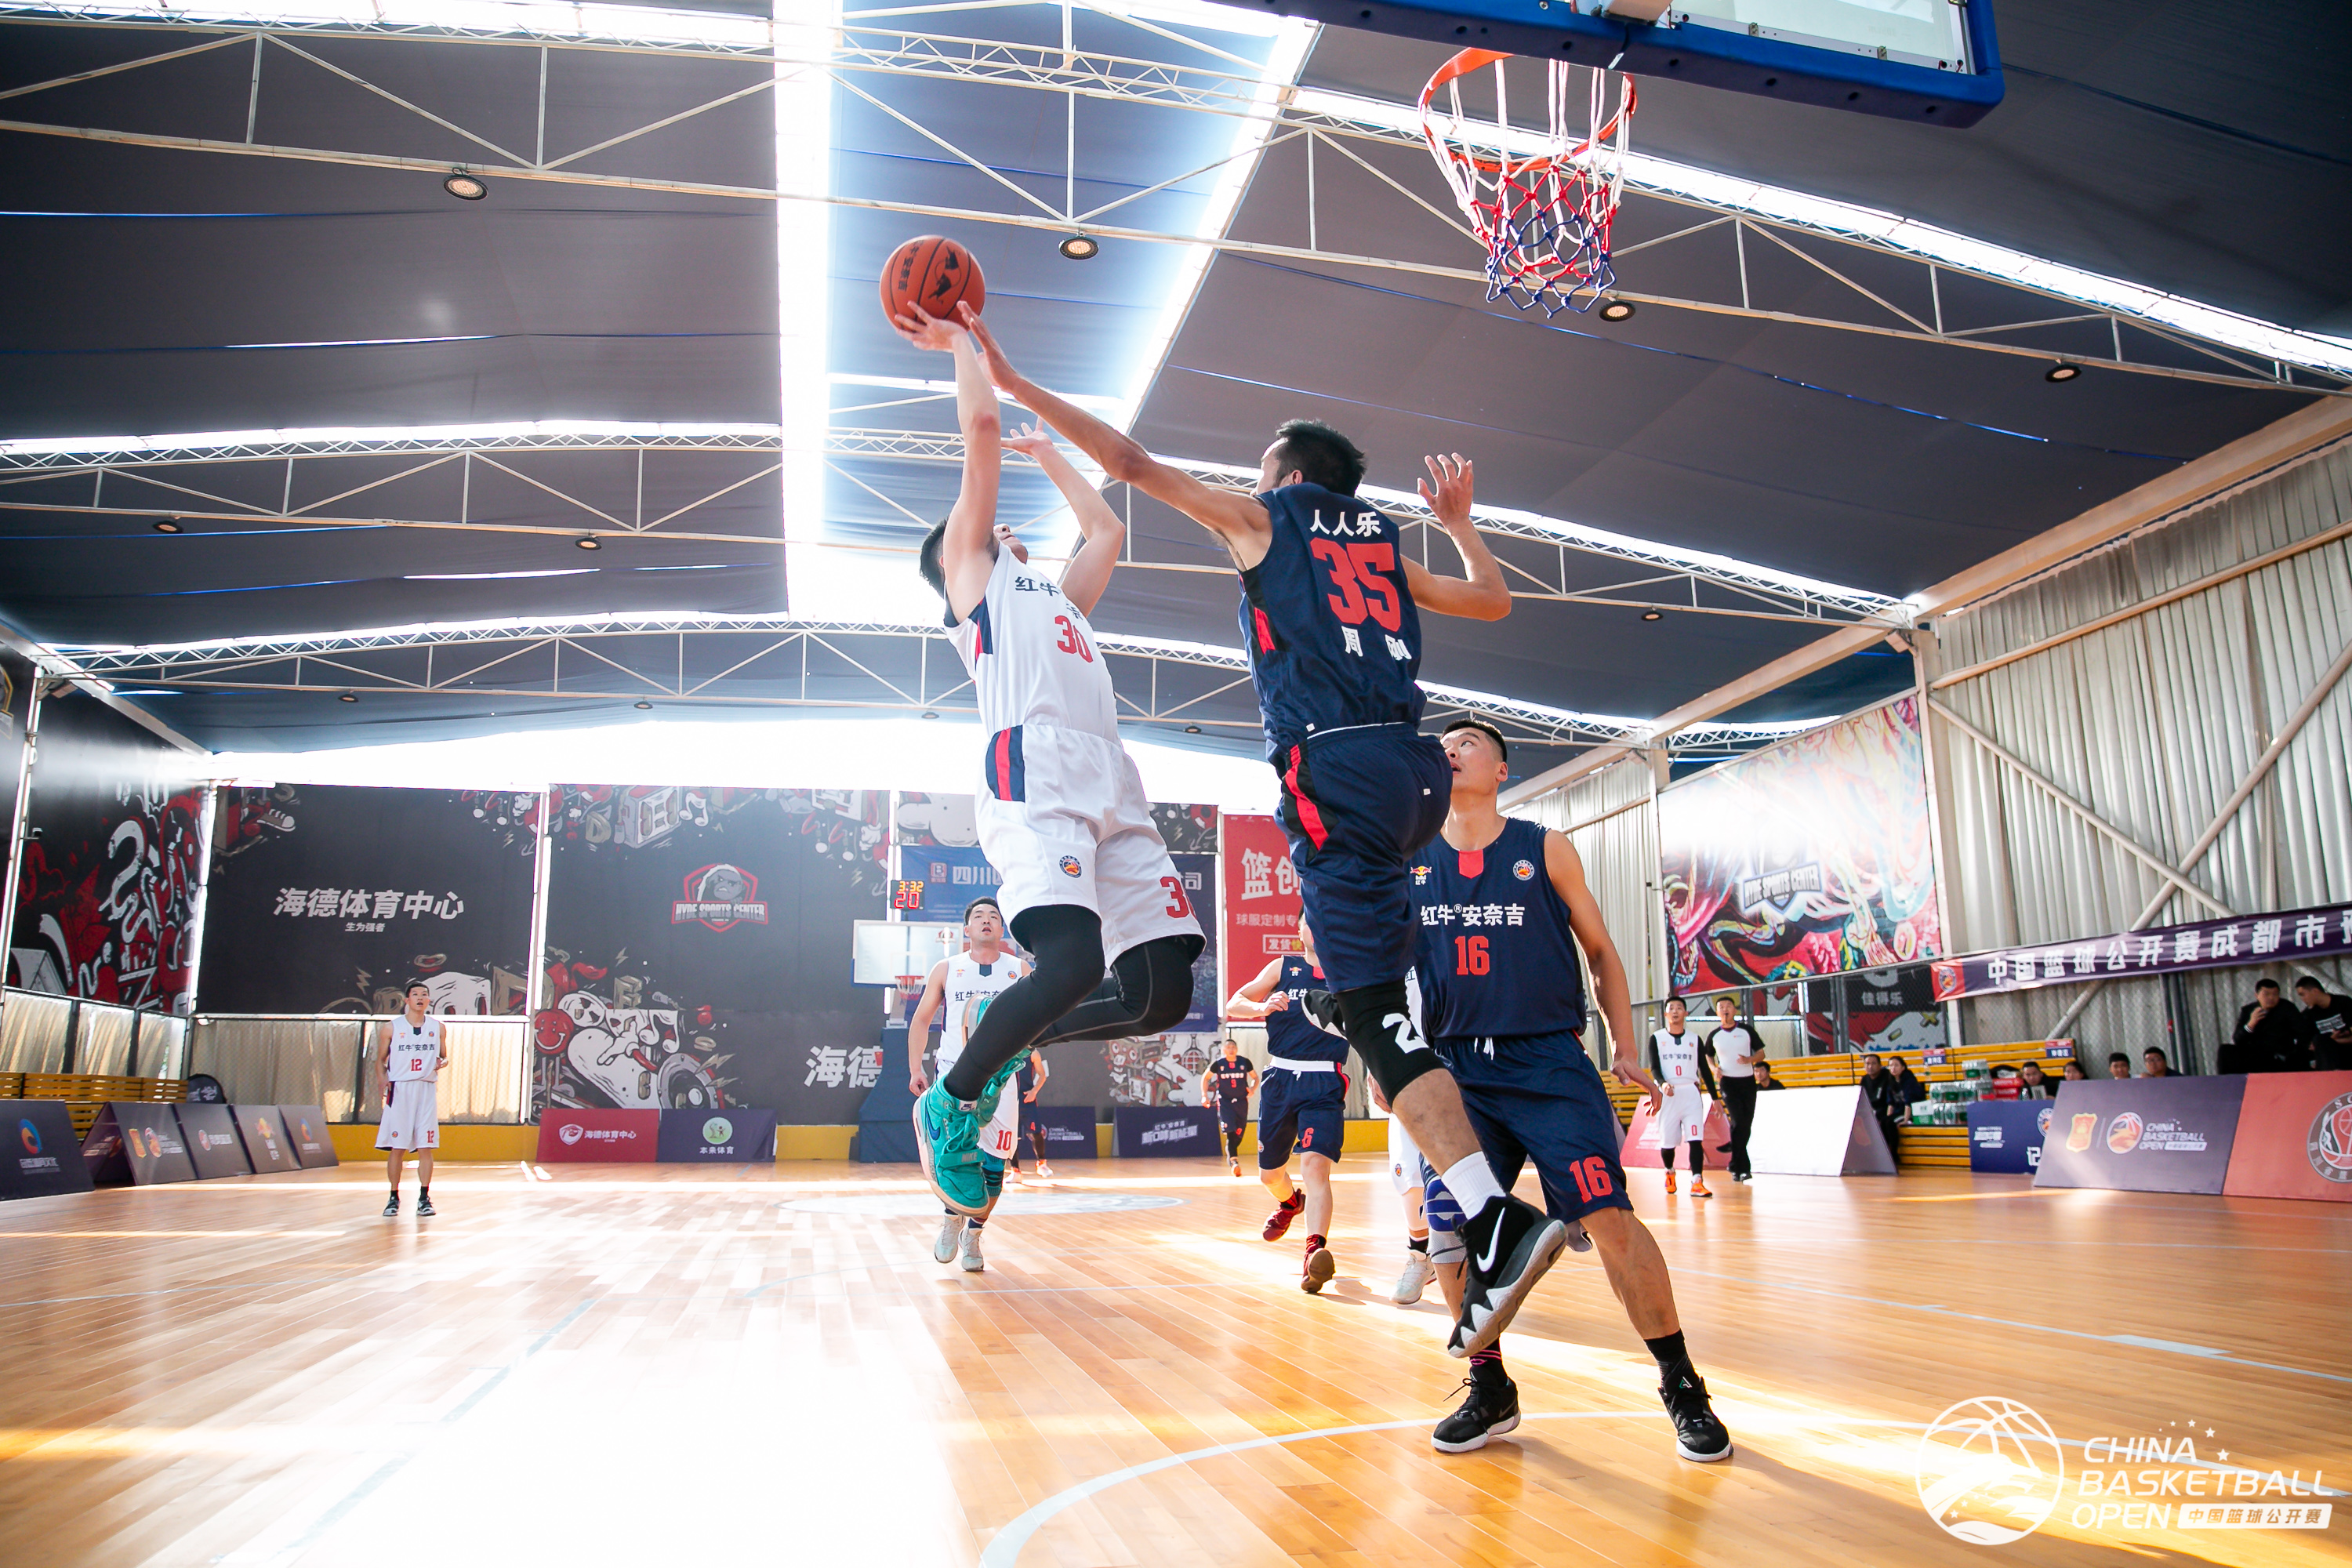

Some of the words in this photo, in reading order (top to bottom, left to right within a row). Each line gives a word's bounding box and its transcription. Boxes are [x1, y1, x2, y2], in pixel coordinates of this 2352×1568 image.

[1310, 510, 1382, 537] 人人乐
[1310, 537, 1402, 632] 35
[1054, 615, 1094, 663] 30
[899, 880, 924, 892] 3:32
[1181, 872, 1203, 891] 司
[1762, 871, 1791, 899] SPORTS
[1791, 864, 1820, 892] CENTER
[273, 887, 465, 920] 海德体育中心
[894, 891, 920, 909] 20
[1160, 876, 1198, 920] 3
[699, 903, 731, 918] SPORTS
[733, 904, 765, 922] CENTER
[1236, 913, 1298, 927] 球服定制专
[1421, 903, 1525, 927] 红牛®安奈吉
[345, 923, 386, 932] 生为强者
[1269, 938, 1302, 951] 发货快
[1454, 935, 1490, 976] 16
[411, 1058, 423, 1072] 12
[1675, 1065, 1682, 1076] 0
[1691, 1124, 1698, 1136] 0
[2146, 1123, 2175, 1131] CHINA
[996, 1130, 1012, 1151] 10
[1301, 1127, 1315, 1149] 6
[2138, 1142, 2164, 1150] OPEN
[2142, 1133, 2205, 1142] BASKETBALL
[961, 1152, 978, 1163] NIKE
[1569, 1156, 1613, 1203] 16
